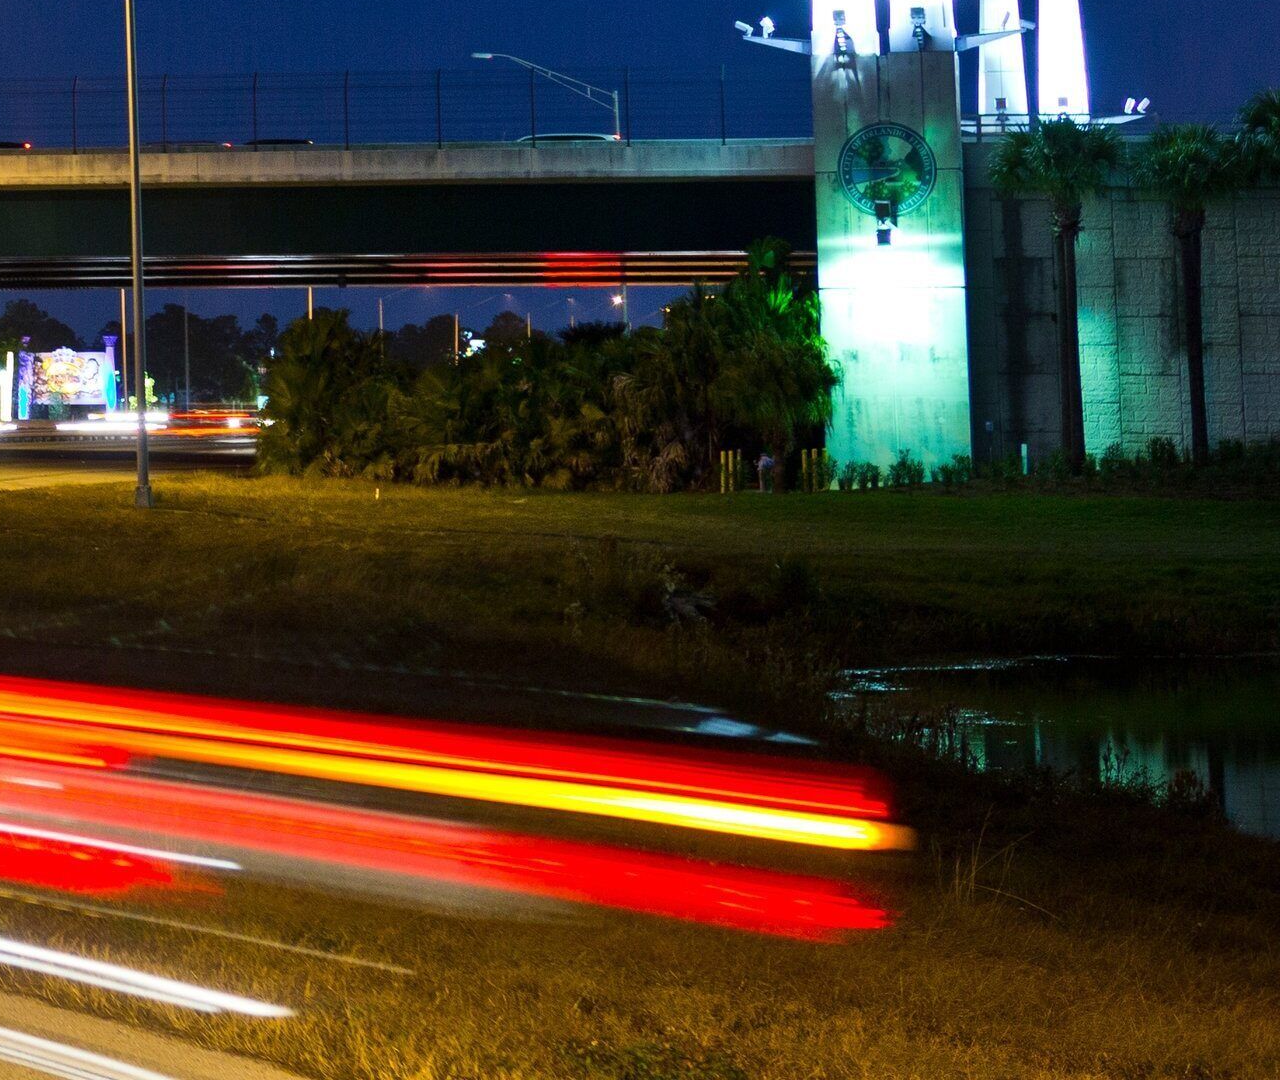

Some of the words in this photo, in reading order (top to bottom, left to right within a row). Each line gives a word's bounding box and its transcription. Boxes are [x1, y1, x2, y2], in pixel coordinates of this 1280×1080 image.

[844, 152, 854, 171] CITY
[851, 138, 862, 150] OF
[847, 183, 861, 201] THE
